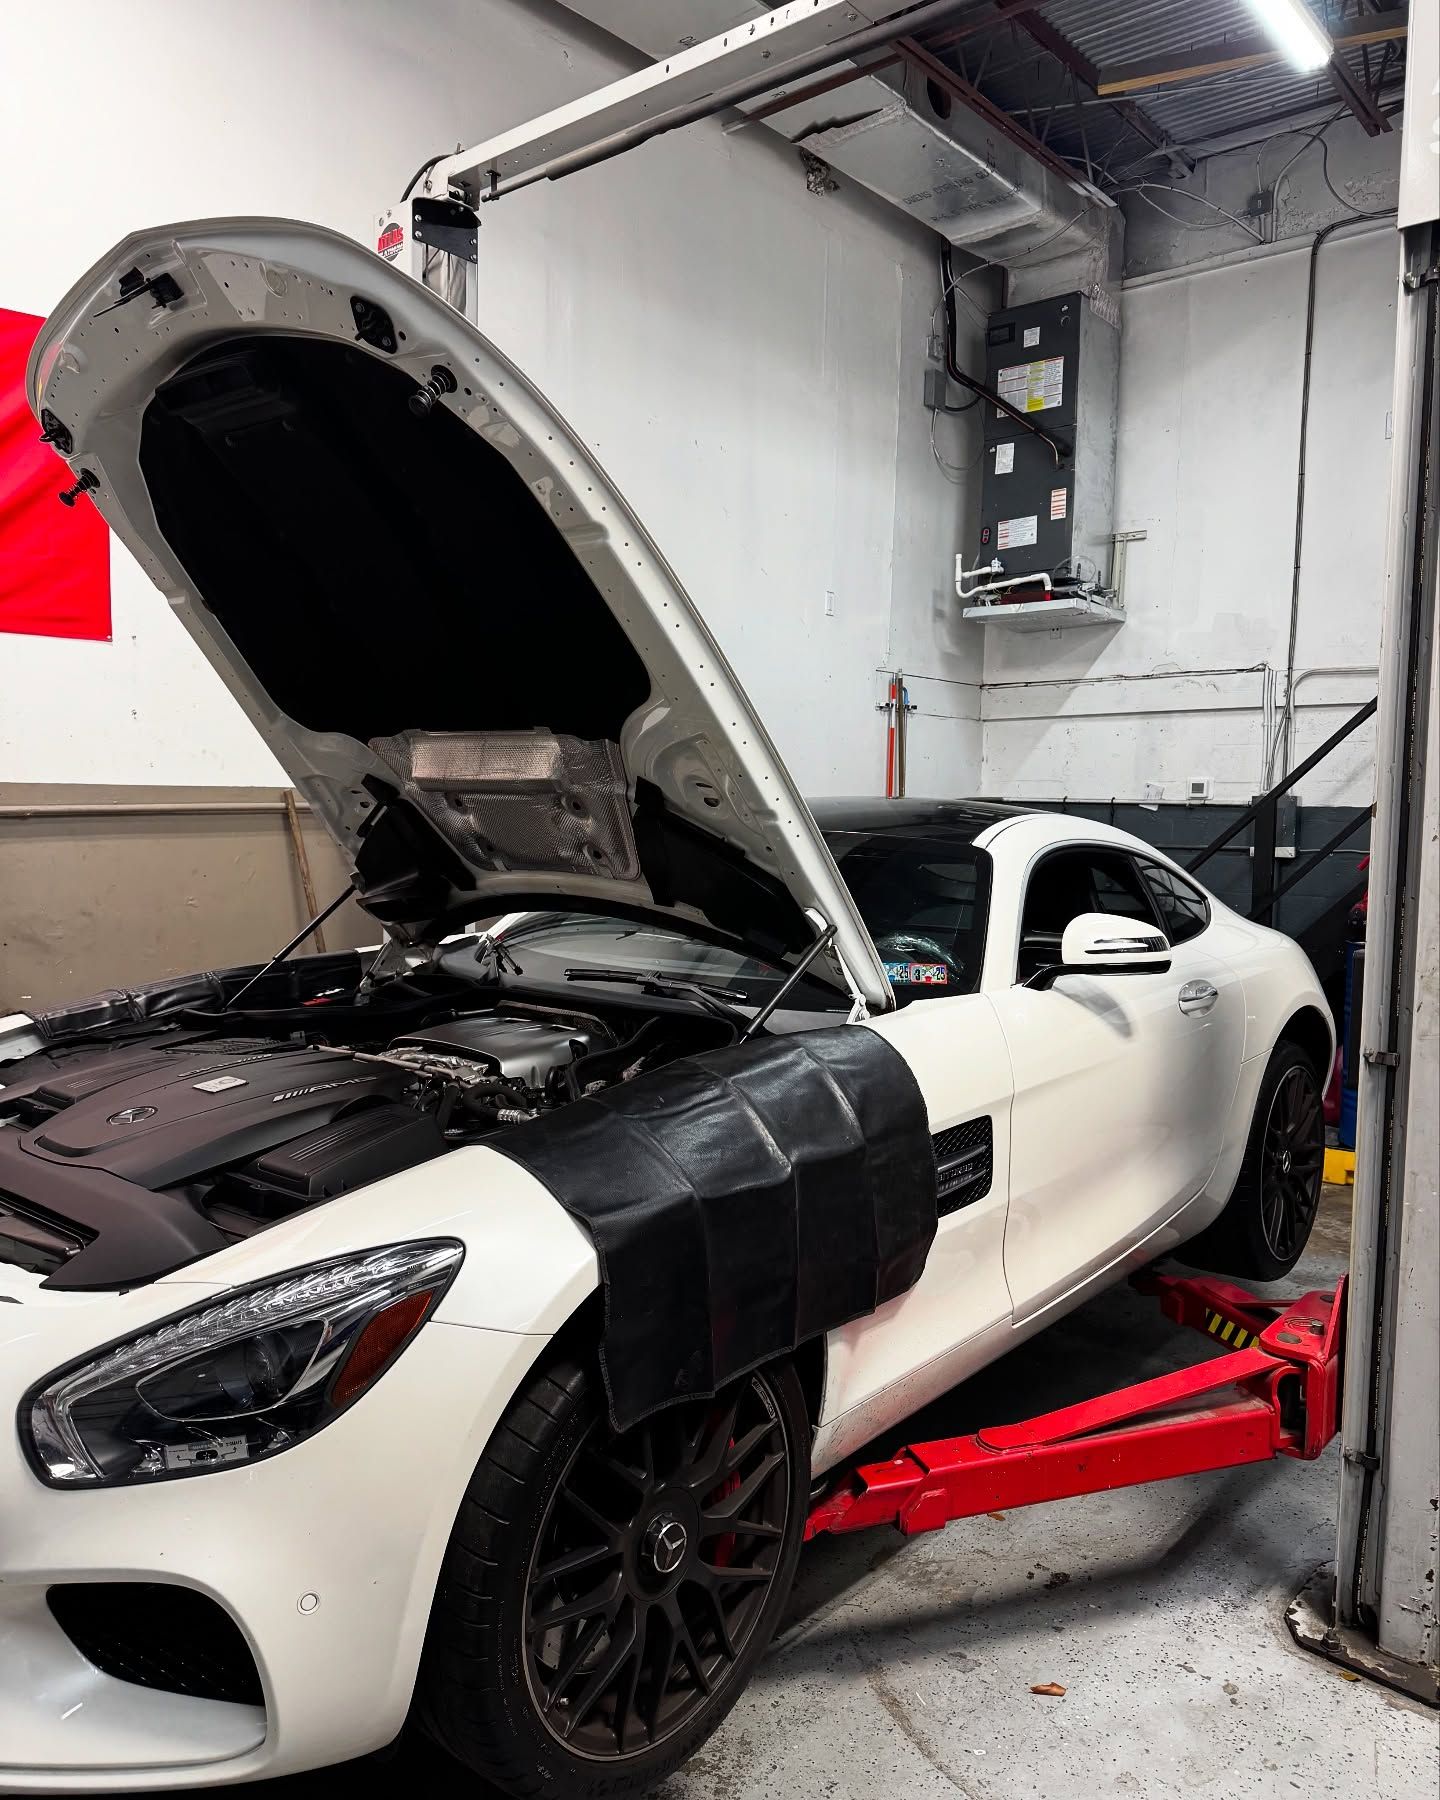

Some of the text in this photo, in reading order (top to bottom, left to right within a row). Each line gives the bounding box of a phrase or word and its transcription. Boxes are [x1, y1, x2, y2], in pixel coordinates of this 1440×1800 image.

[378, 227, 403, 250] ATLAS
[914, 966, 945, 981] 3 25
